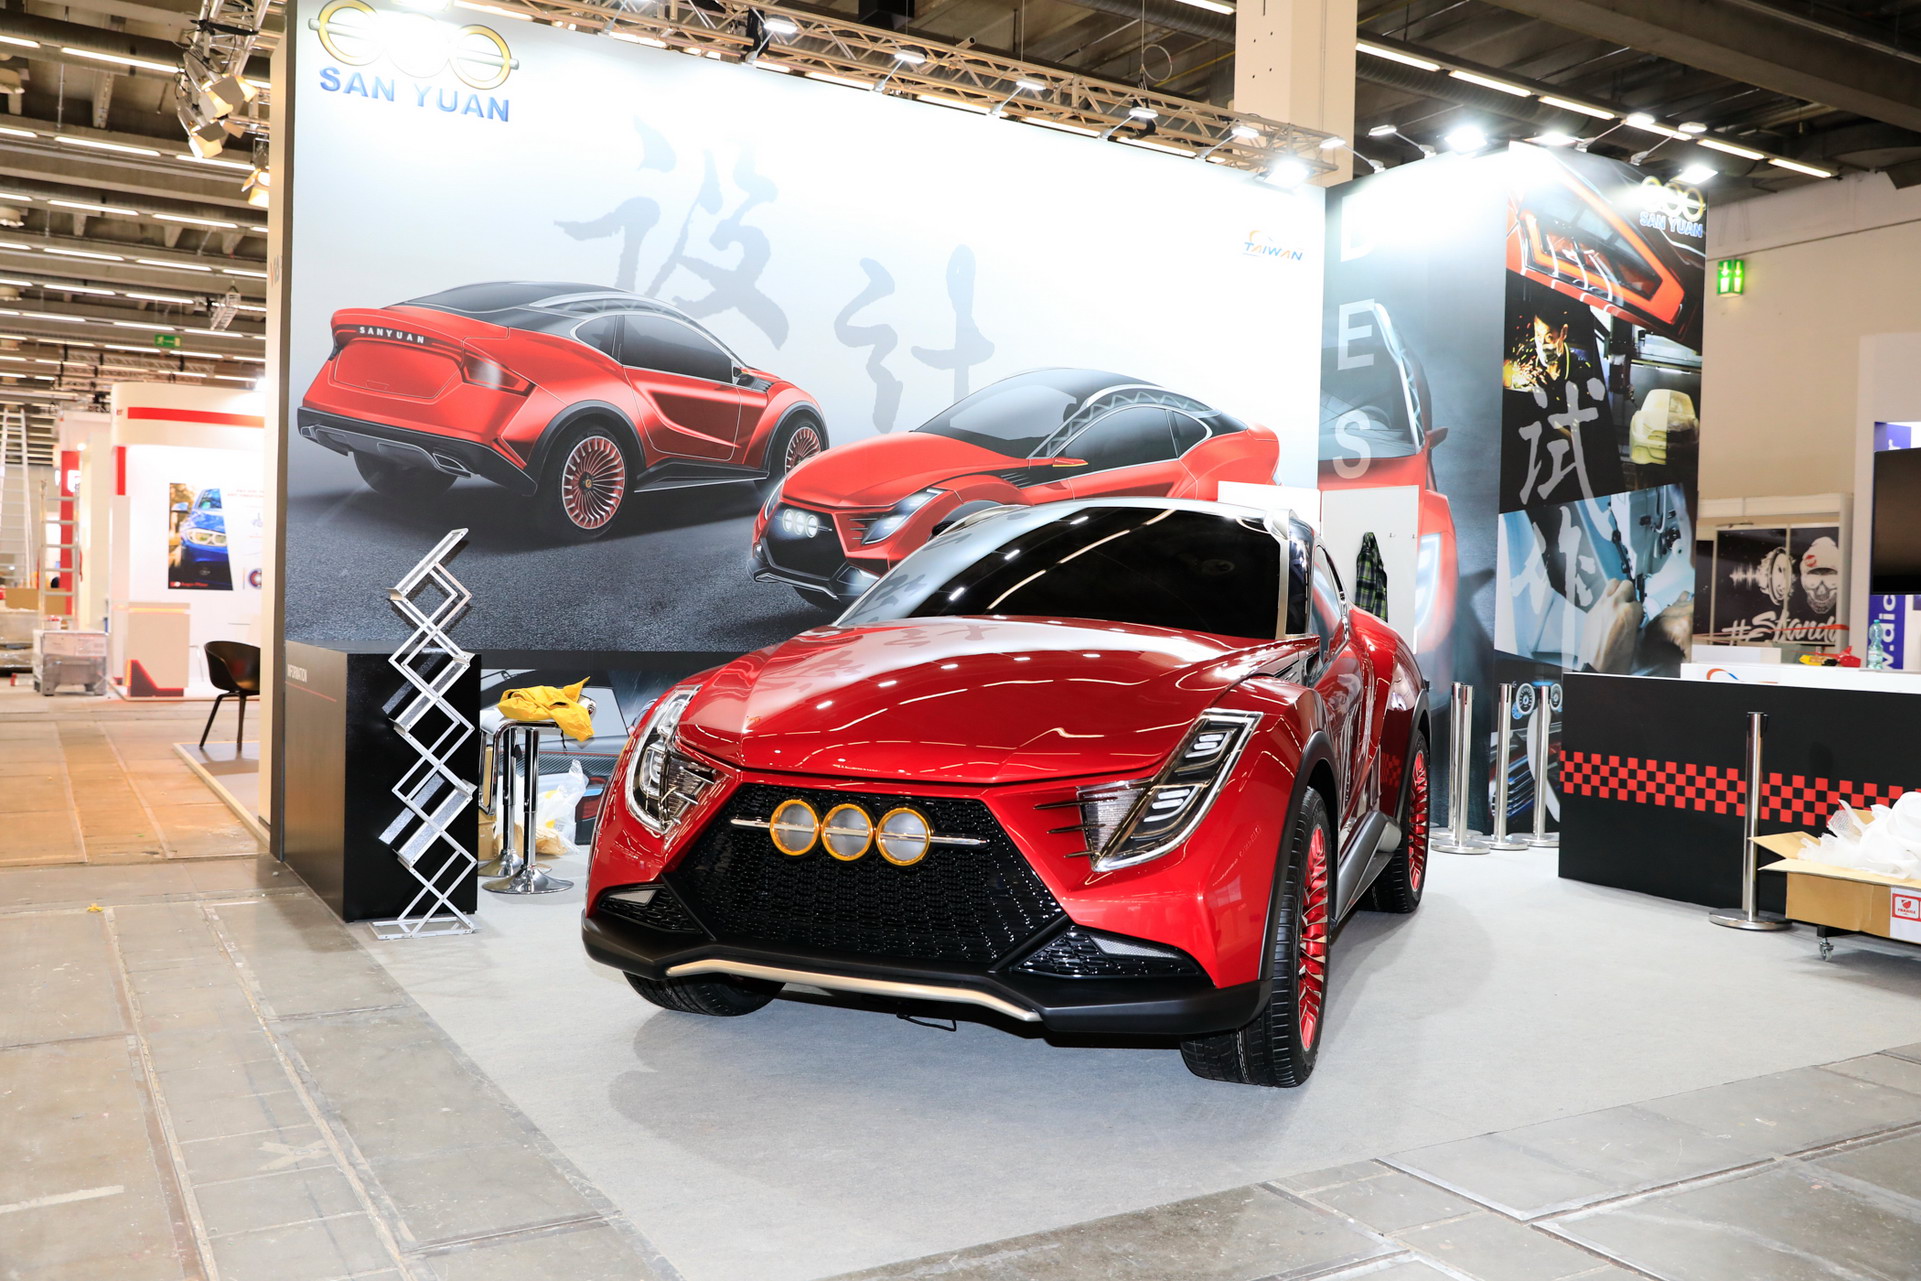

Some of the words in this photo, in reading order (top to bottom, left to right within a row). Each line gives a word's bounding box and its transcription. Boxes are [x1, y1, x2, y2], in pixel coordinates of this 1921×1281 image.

[319, 66, 395, 102] SAN
[414, 83, 509, 122] YUAN
[1640, 211, 1666, 230] SAN
[1668, 216, 1703, 238] YUAN
[1244, 241, 1303, 261] TAIWAN
[360, 326, 425, 344] SANYUAN
